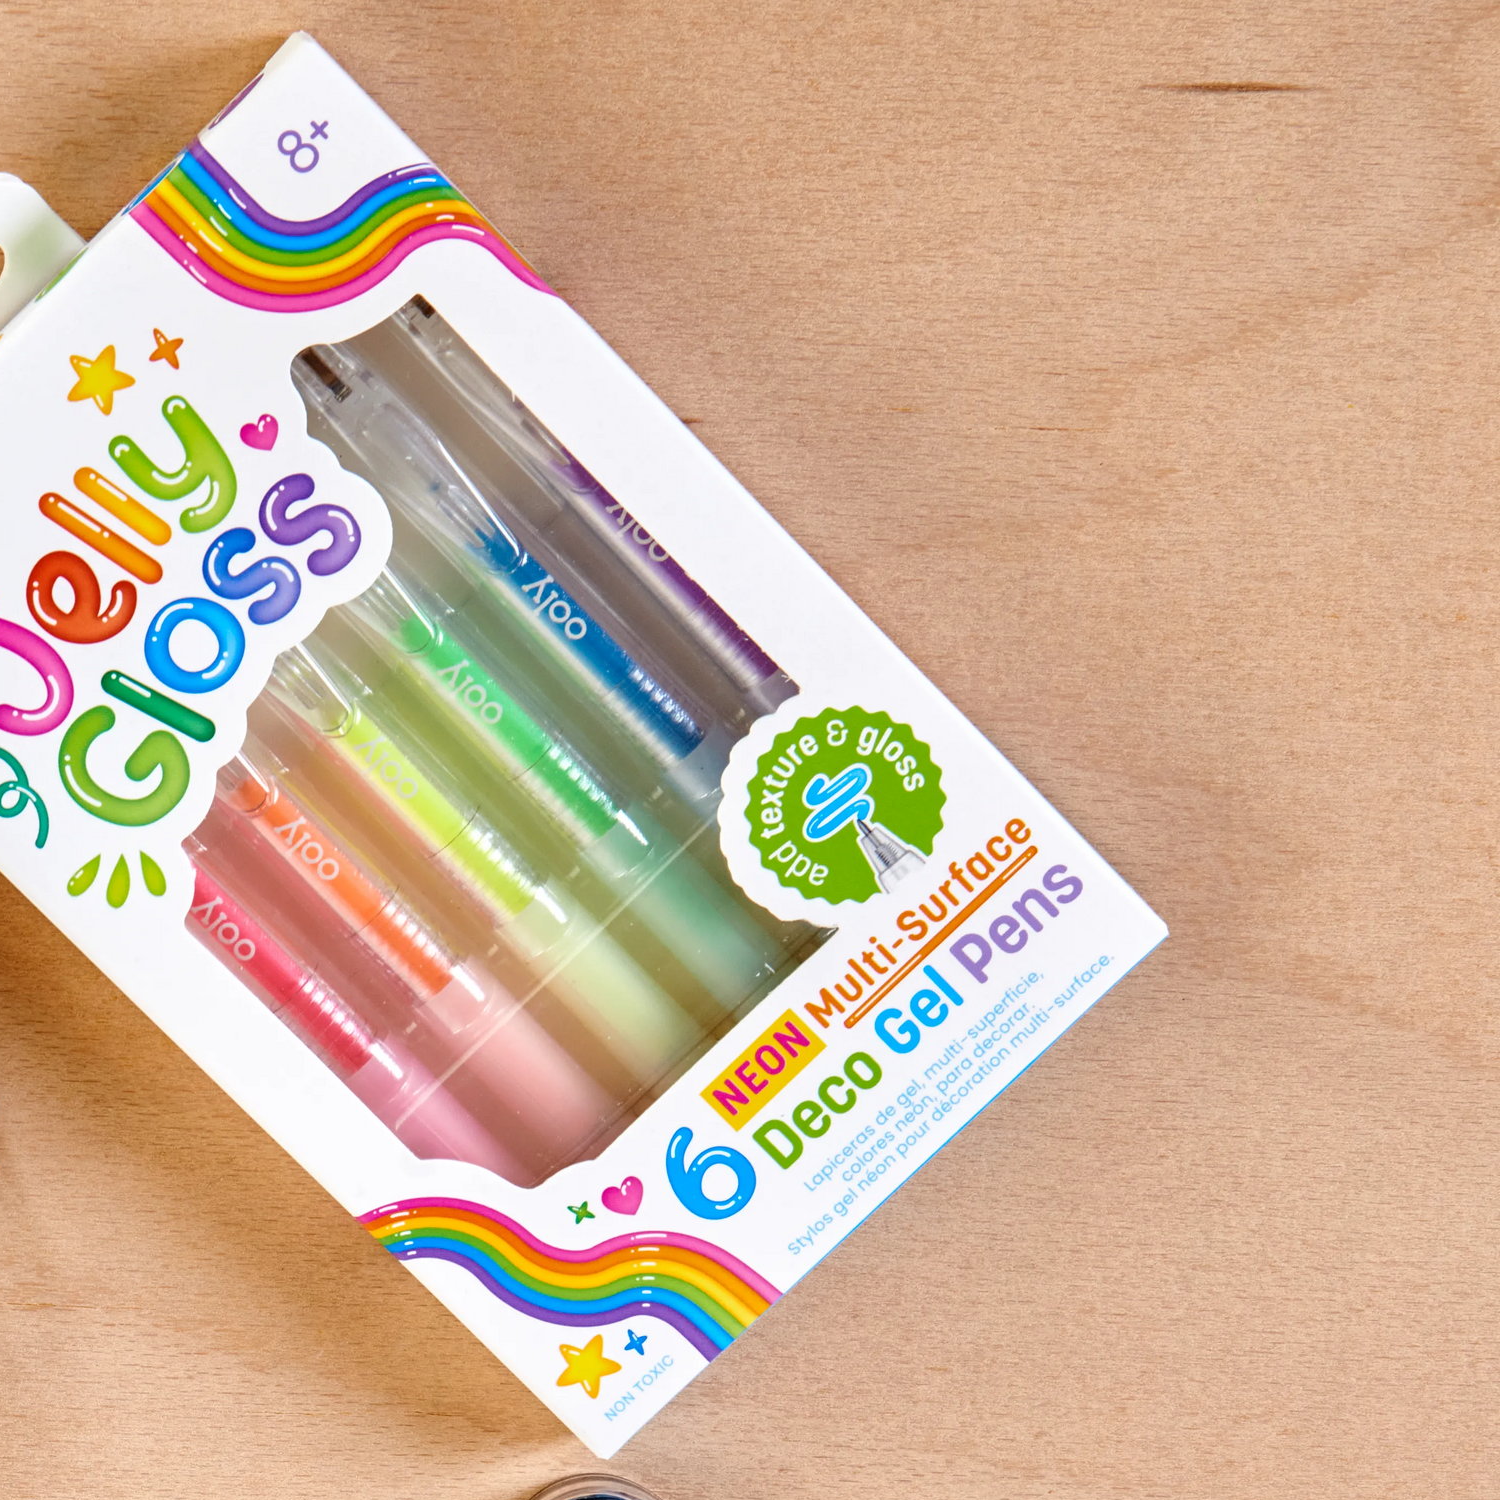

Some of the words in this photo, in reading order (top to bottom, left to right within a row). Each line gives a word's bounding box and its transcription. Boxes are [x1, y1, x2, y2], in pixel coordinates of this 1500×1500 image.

[277, 119, 329, 174] 8+
[521, 574, 587, 640] ooly
[57, 473, 362, 828] Gloss
[437, 659, 503, 724] ooly
[826, 719, 849, 747] &
[856, 726, 925, 792] gloss
[353, 735, 419, 799] ooly
[760, 734, 819, 839] texture
[273, 815, 340, 881] ooly
[768, 840, 829, 886] add
[190, 895, 256, 962] ooly
[711, 1020, 811, 1117] NEON
[803, 817, 1033, 1029] Multi-Surface
[665, 1126, 757, 1221] 6
[752, 1051, 884, 1170] Deco
[874, 964, 965, 1055] Gel
[949, 864, 1083, 984] Pens
[787, 1212, 834, 1256] Stylos
[832, 1187, 858, 1218] gel
[856, 1153, 897, 1192] néon
[895, 1120, 931, 1160] pour
[931, 1045, 1011, 1122] décoration
[1008, 953, 1116, 1050] multi-surface.
[803, 1125, 876, 1193] Lapiceras
[875, 1105, 897, 1127] de
[895, 1078, 928, 1108] gel,
[923, 970, 1045, 1082] multi-superficie,
[841, 1130, 896, 1183] colores
[937, 1056, 973, 1097] para
[972, 1003, 1038, 1059] decorar.
[604, 1391, 636, 1422] NON
[632, 1354, 675, 1392] TOXIC
